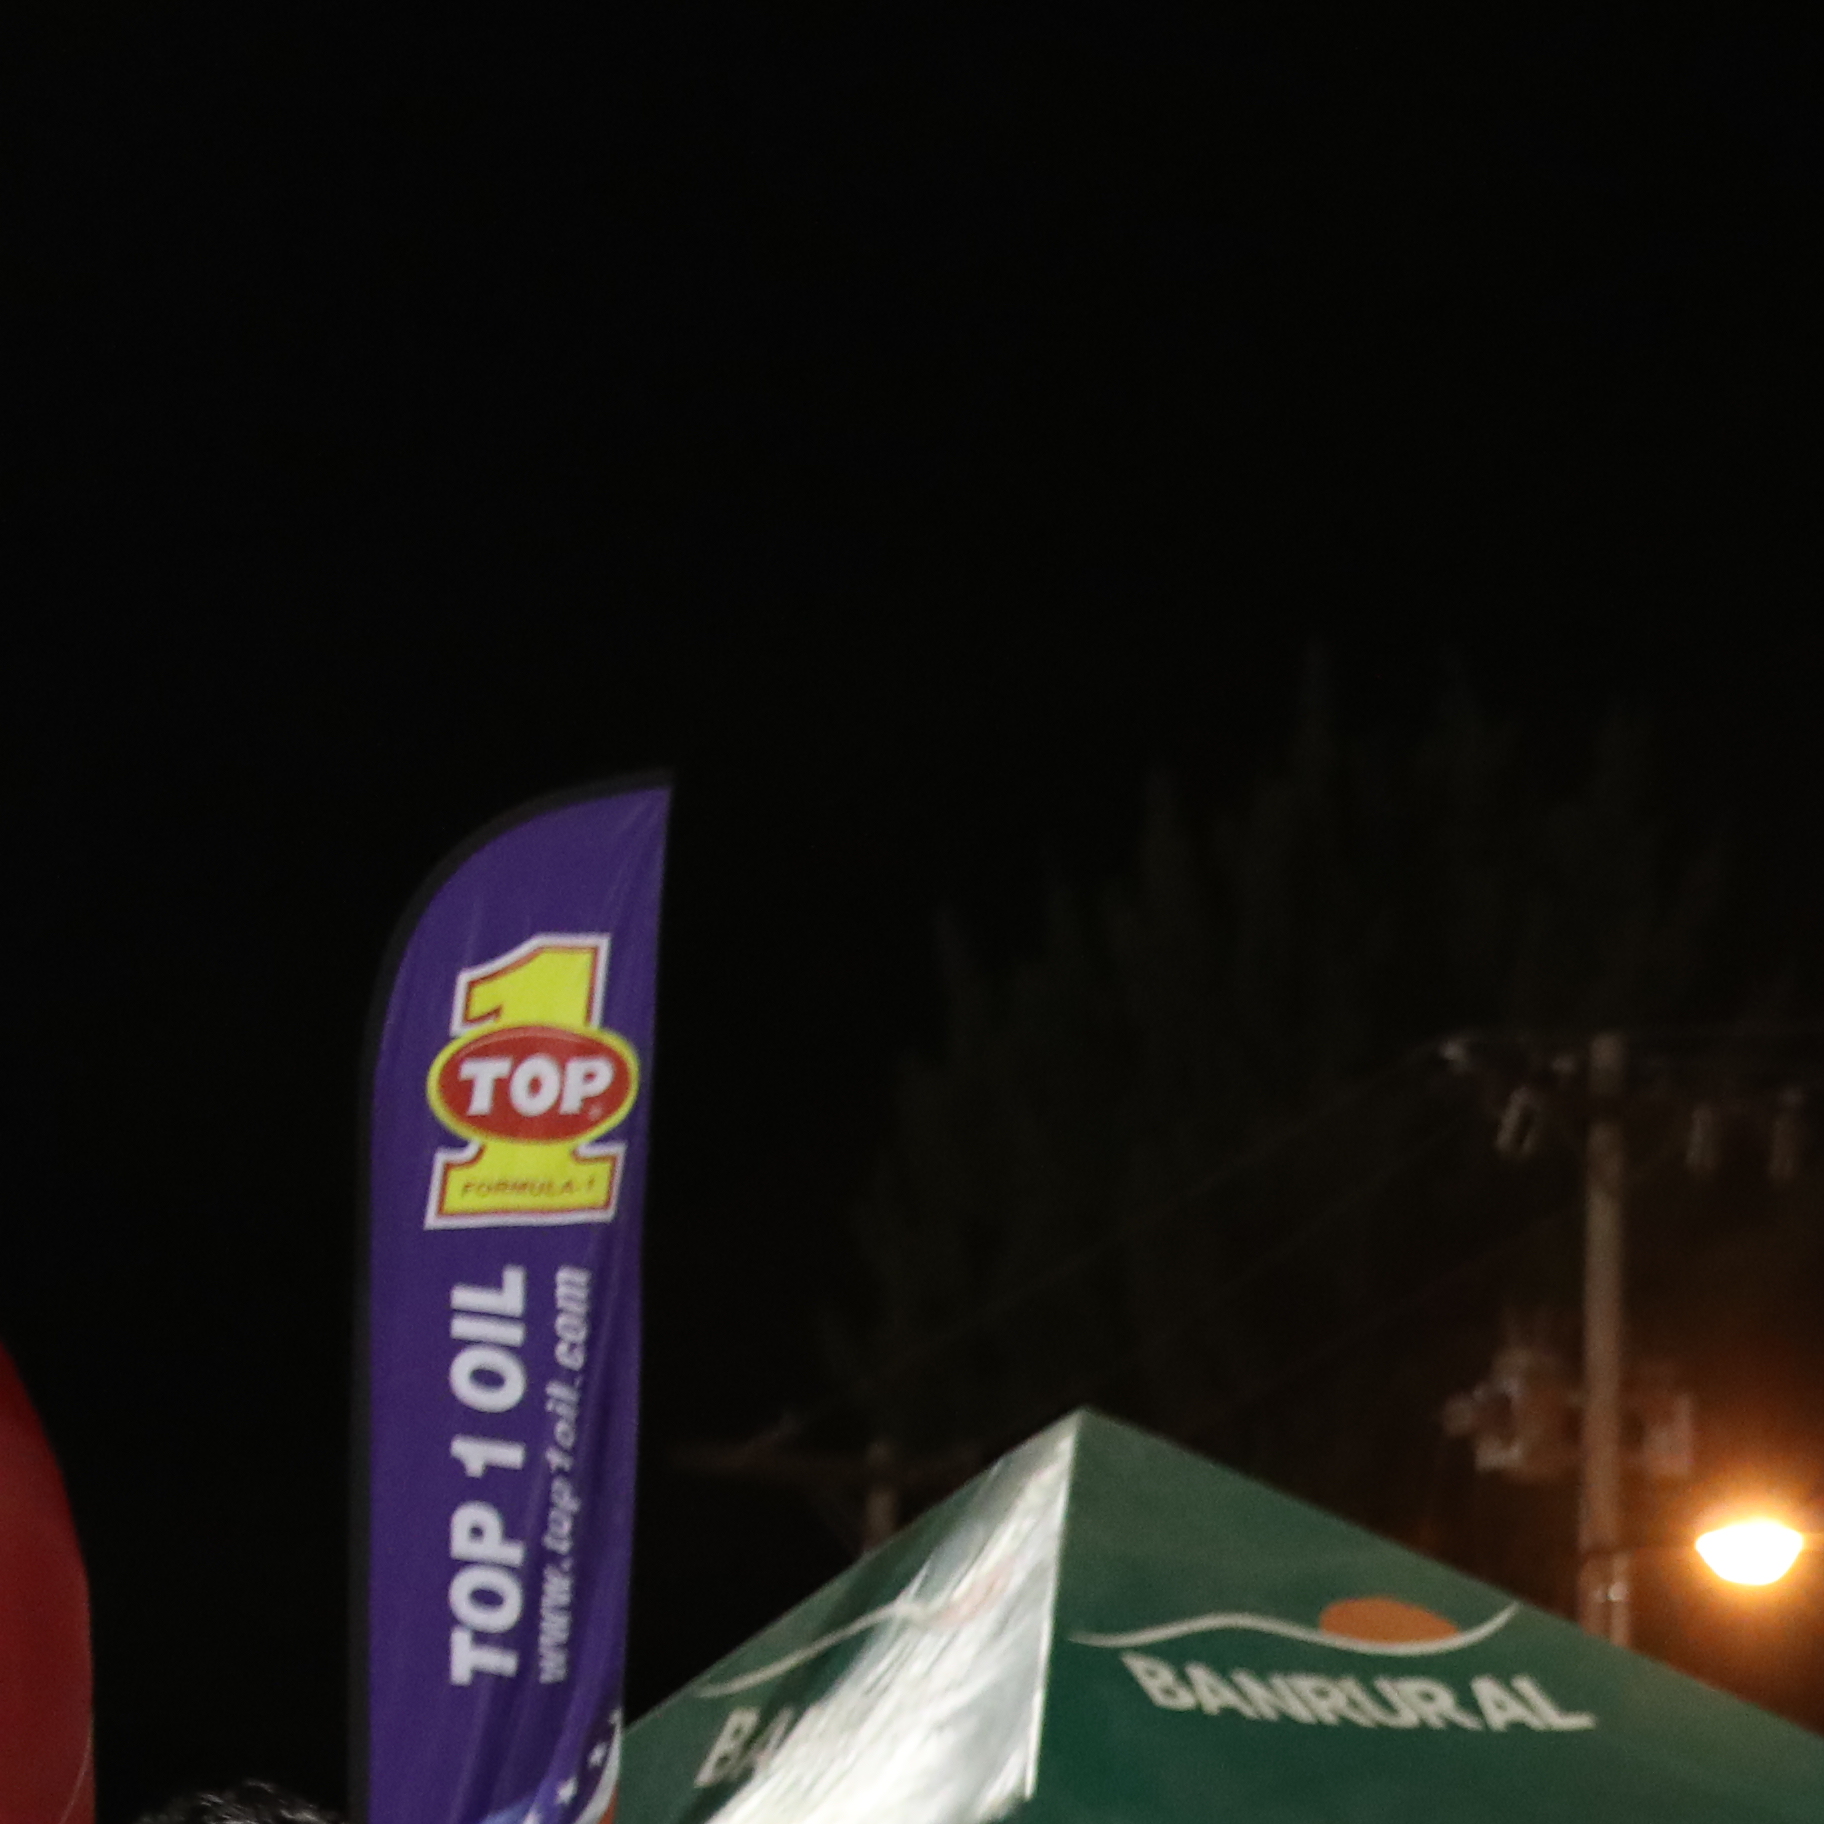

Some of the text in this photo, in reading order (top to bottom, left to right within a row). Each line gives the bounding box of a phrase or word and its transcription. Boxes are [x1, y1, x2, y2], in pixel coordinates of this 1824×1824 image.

[458, 1053, 617, 1117] TOP
[449, 1264, 528, 1687] TOP 1 OIL
[538, 1264, 593, 1685] www.top1oil.com
[1120, 1651, 1597, 1732] BANRURAL
